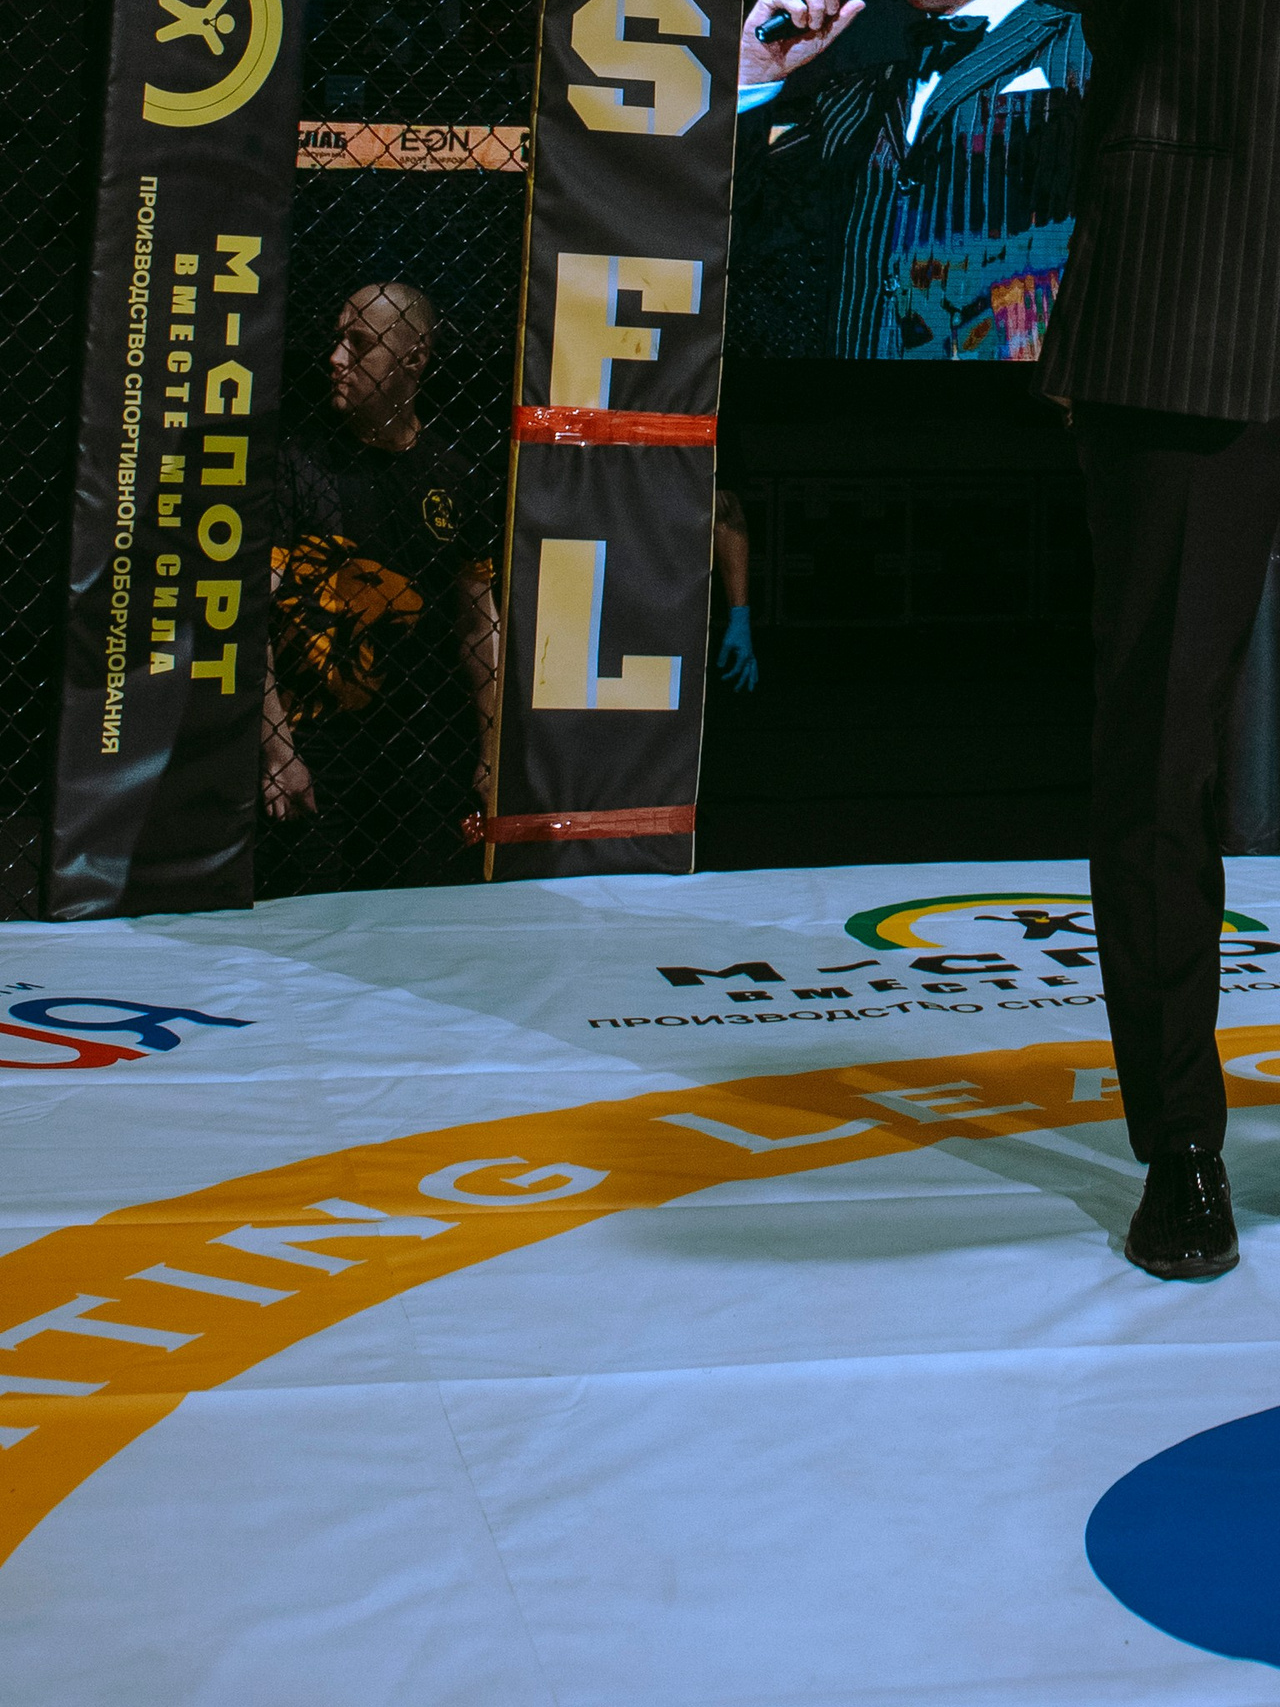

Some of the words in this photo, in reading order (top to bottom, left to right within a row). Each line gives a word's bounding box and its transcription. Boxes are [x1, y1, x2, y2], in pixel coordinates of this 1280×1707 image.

[126, 175, 159, 368] ПРОИЗВОДСТВО
[163, 252, 199, 429] ВМЕСТЕ
[114, 372, 144, 550] СПОРТИВНОГО
[157, 454, 186, 528] МЫ
[190, 233, 263, 695] М-СПОРТ
[101, 555, 133, 754] ОБОРУДОВАНИЯ
[149, 553, 182, 677] СИЛА
[588, 1001, 984, 1029] ПРОИЗВОДСТВО
[727, 974, 1080, 1003] ВМЕСТЕ
